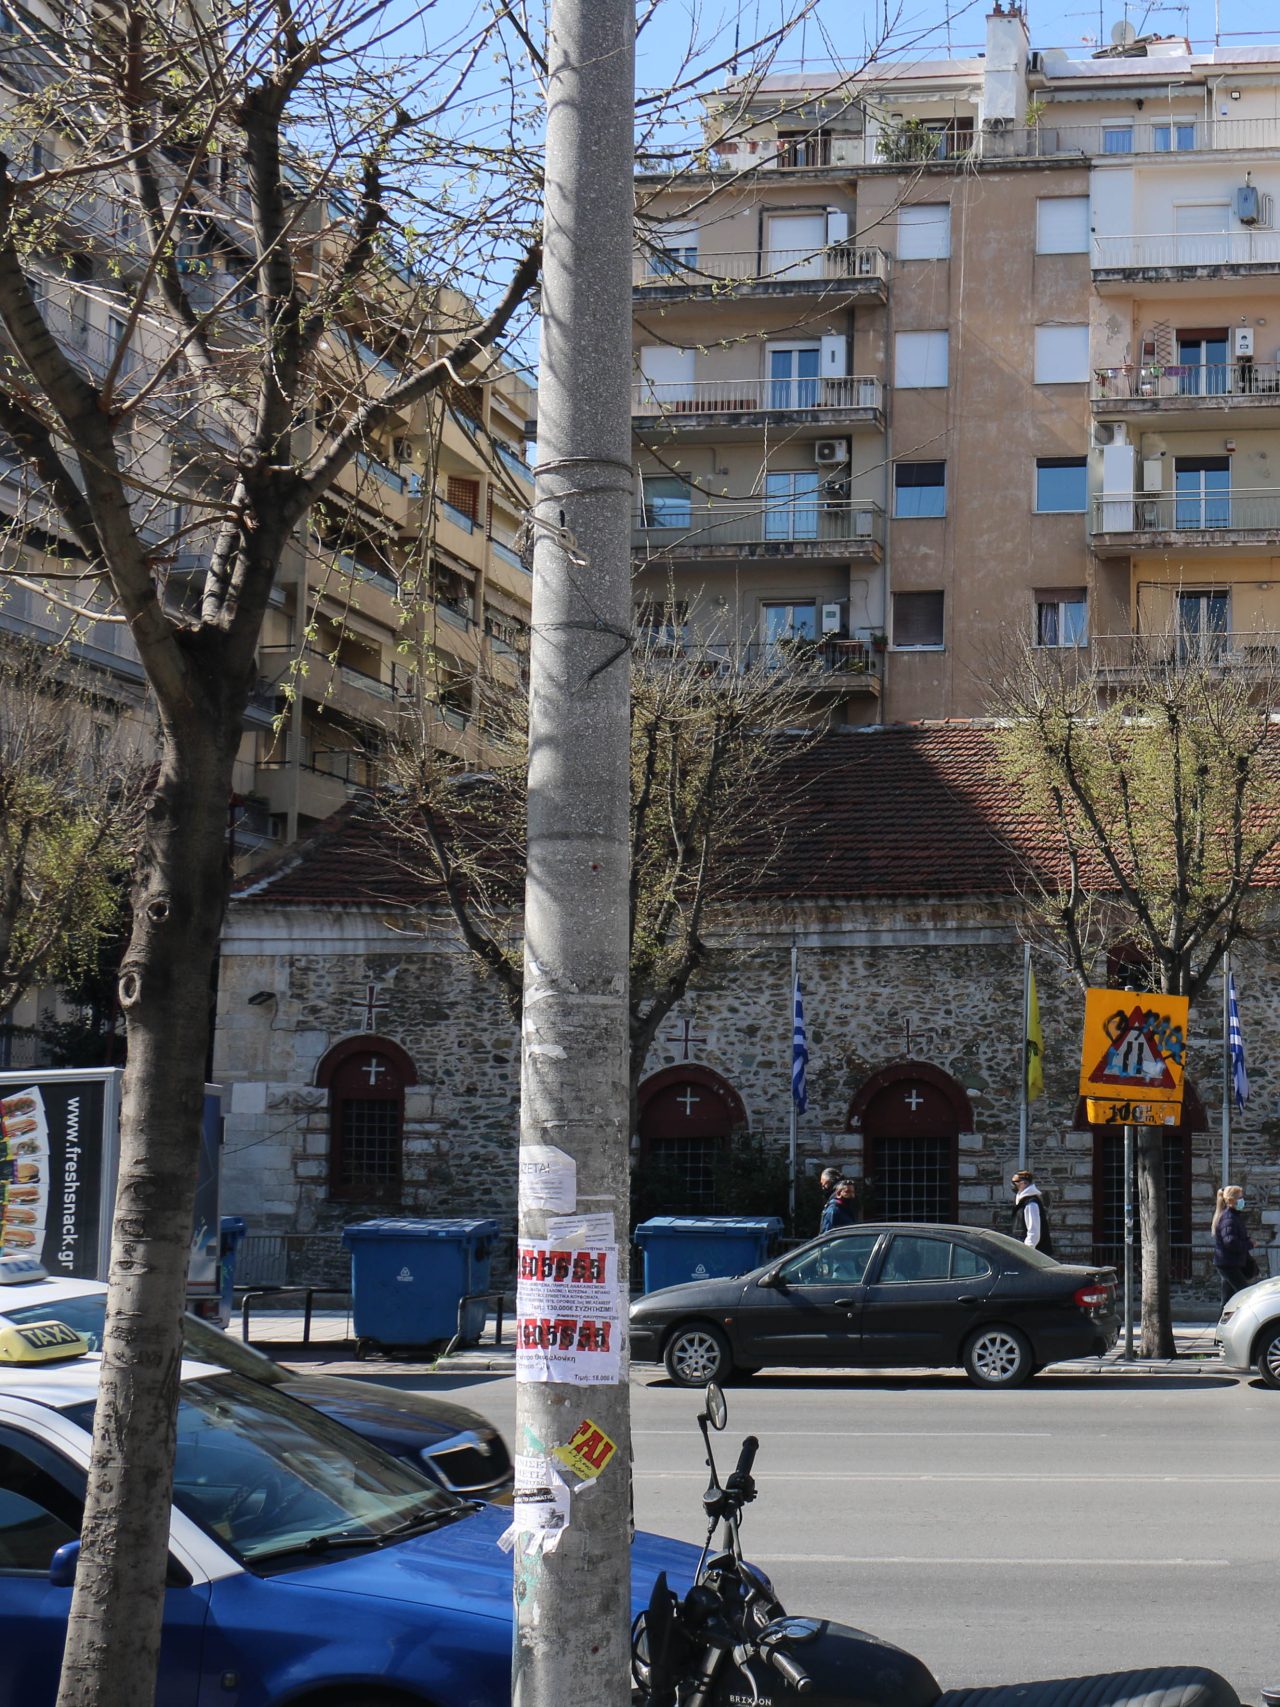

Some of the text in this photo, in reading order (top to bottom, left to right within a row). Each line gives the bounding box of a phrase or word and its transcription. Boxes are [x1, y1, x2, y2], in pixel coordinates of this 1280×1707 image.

[58, 1097, 82, 1271] www.freshsnack.gr
[20, 1325, 77, 1346] TAXI
[729, 1694, 772, 1706] BRIXON
